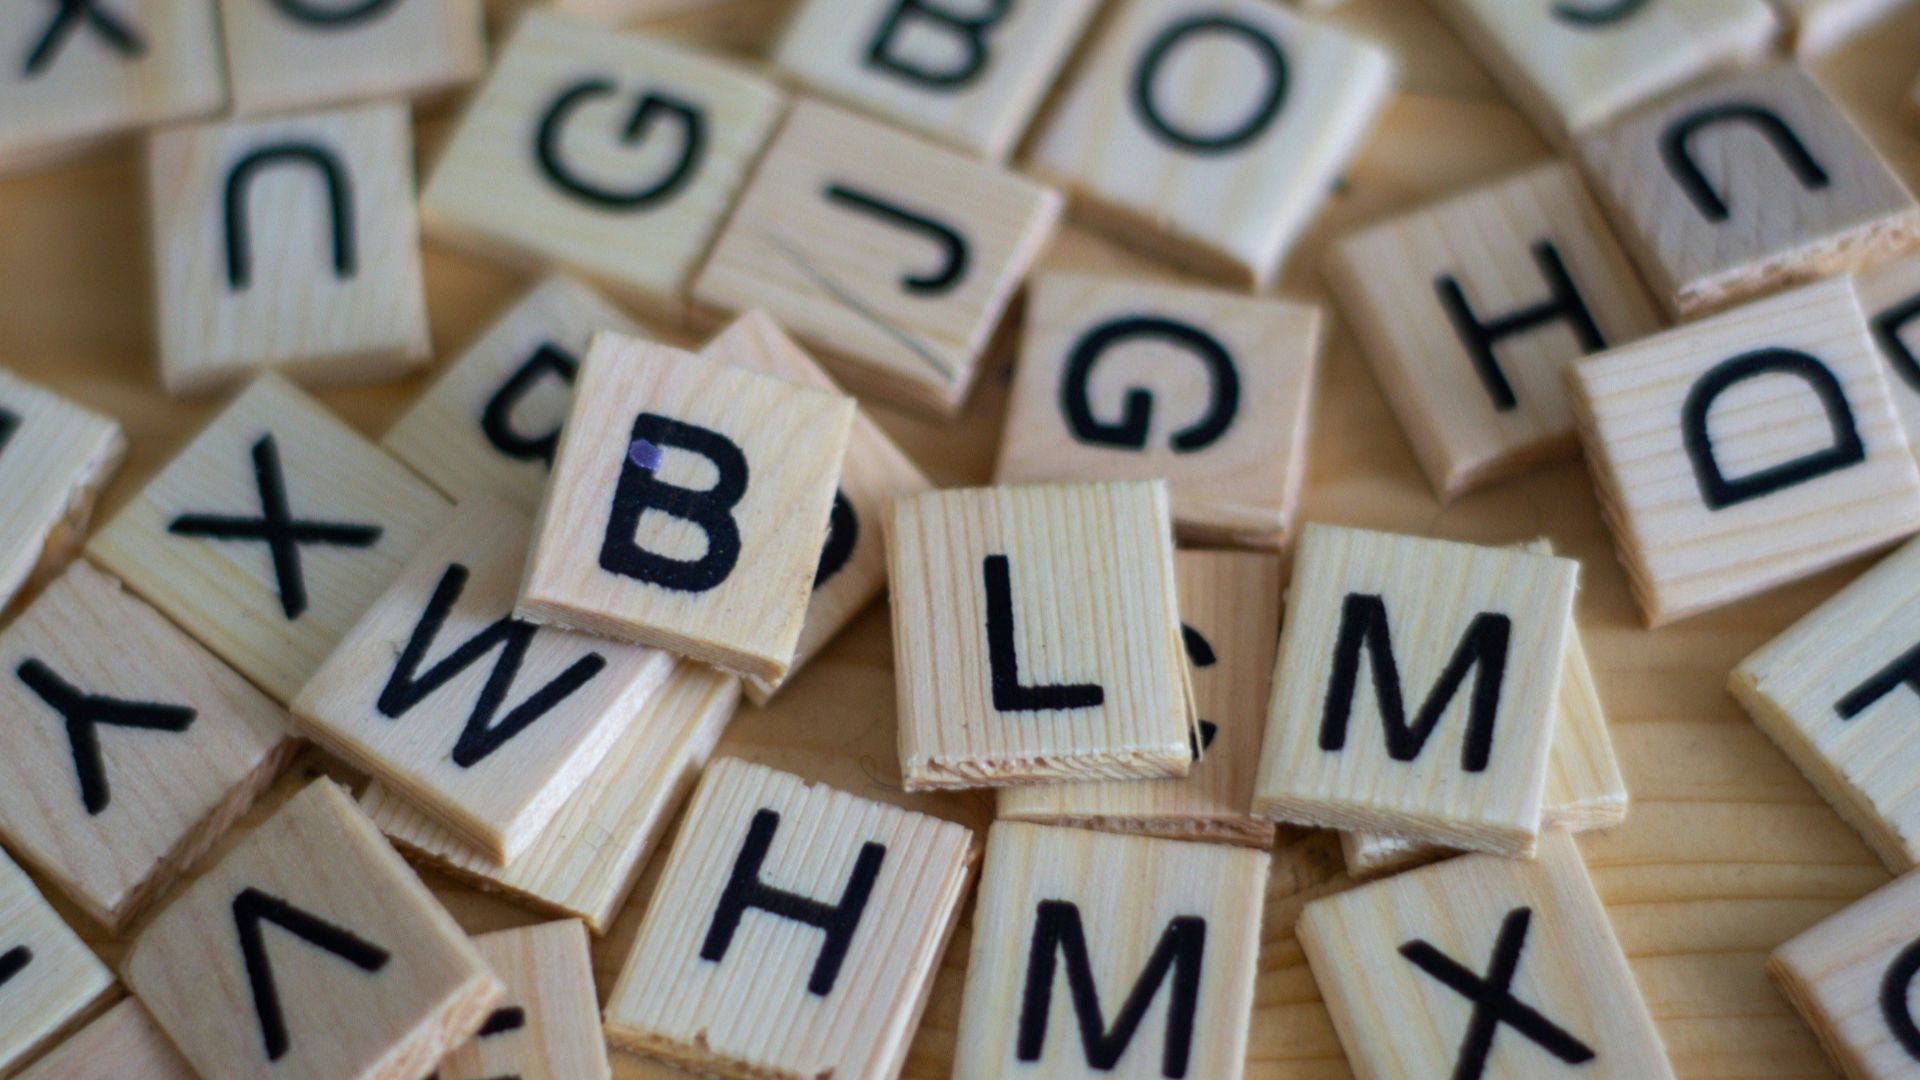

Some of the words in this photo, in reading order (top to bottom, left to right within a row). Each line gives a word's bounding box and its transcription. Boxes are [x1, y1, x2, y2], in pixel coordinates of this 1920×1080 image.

[865, 0, 1014, 90] B
[1133, 15, 1290, 153] O
[223, 142, 356, 291] U
[533, 79, 709, 211] G
[1659, 100, 1832, 225] U
[820, 183, 971, 297] J
[1060, 316, 1242, 454] G
[1435, 239, 1609, 412] H
[599, 413, 749, 594] B
[1683, 348, 1866, 510] D
[168, 432, 384, 620] X
[377, 562, 607, 769] W
[983, 555, 1105, 712] L
[1318, 593, 1512, 773] M
[16, 657, 197, 816] Y
[232, 886, 391, 1062] V
[700, 808, 888, 997] H
[1017, 899, 1207, 1080] M
[1398, 907, 1596, 1080] X
